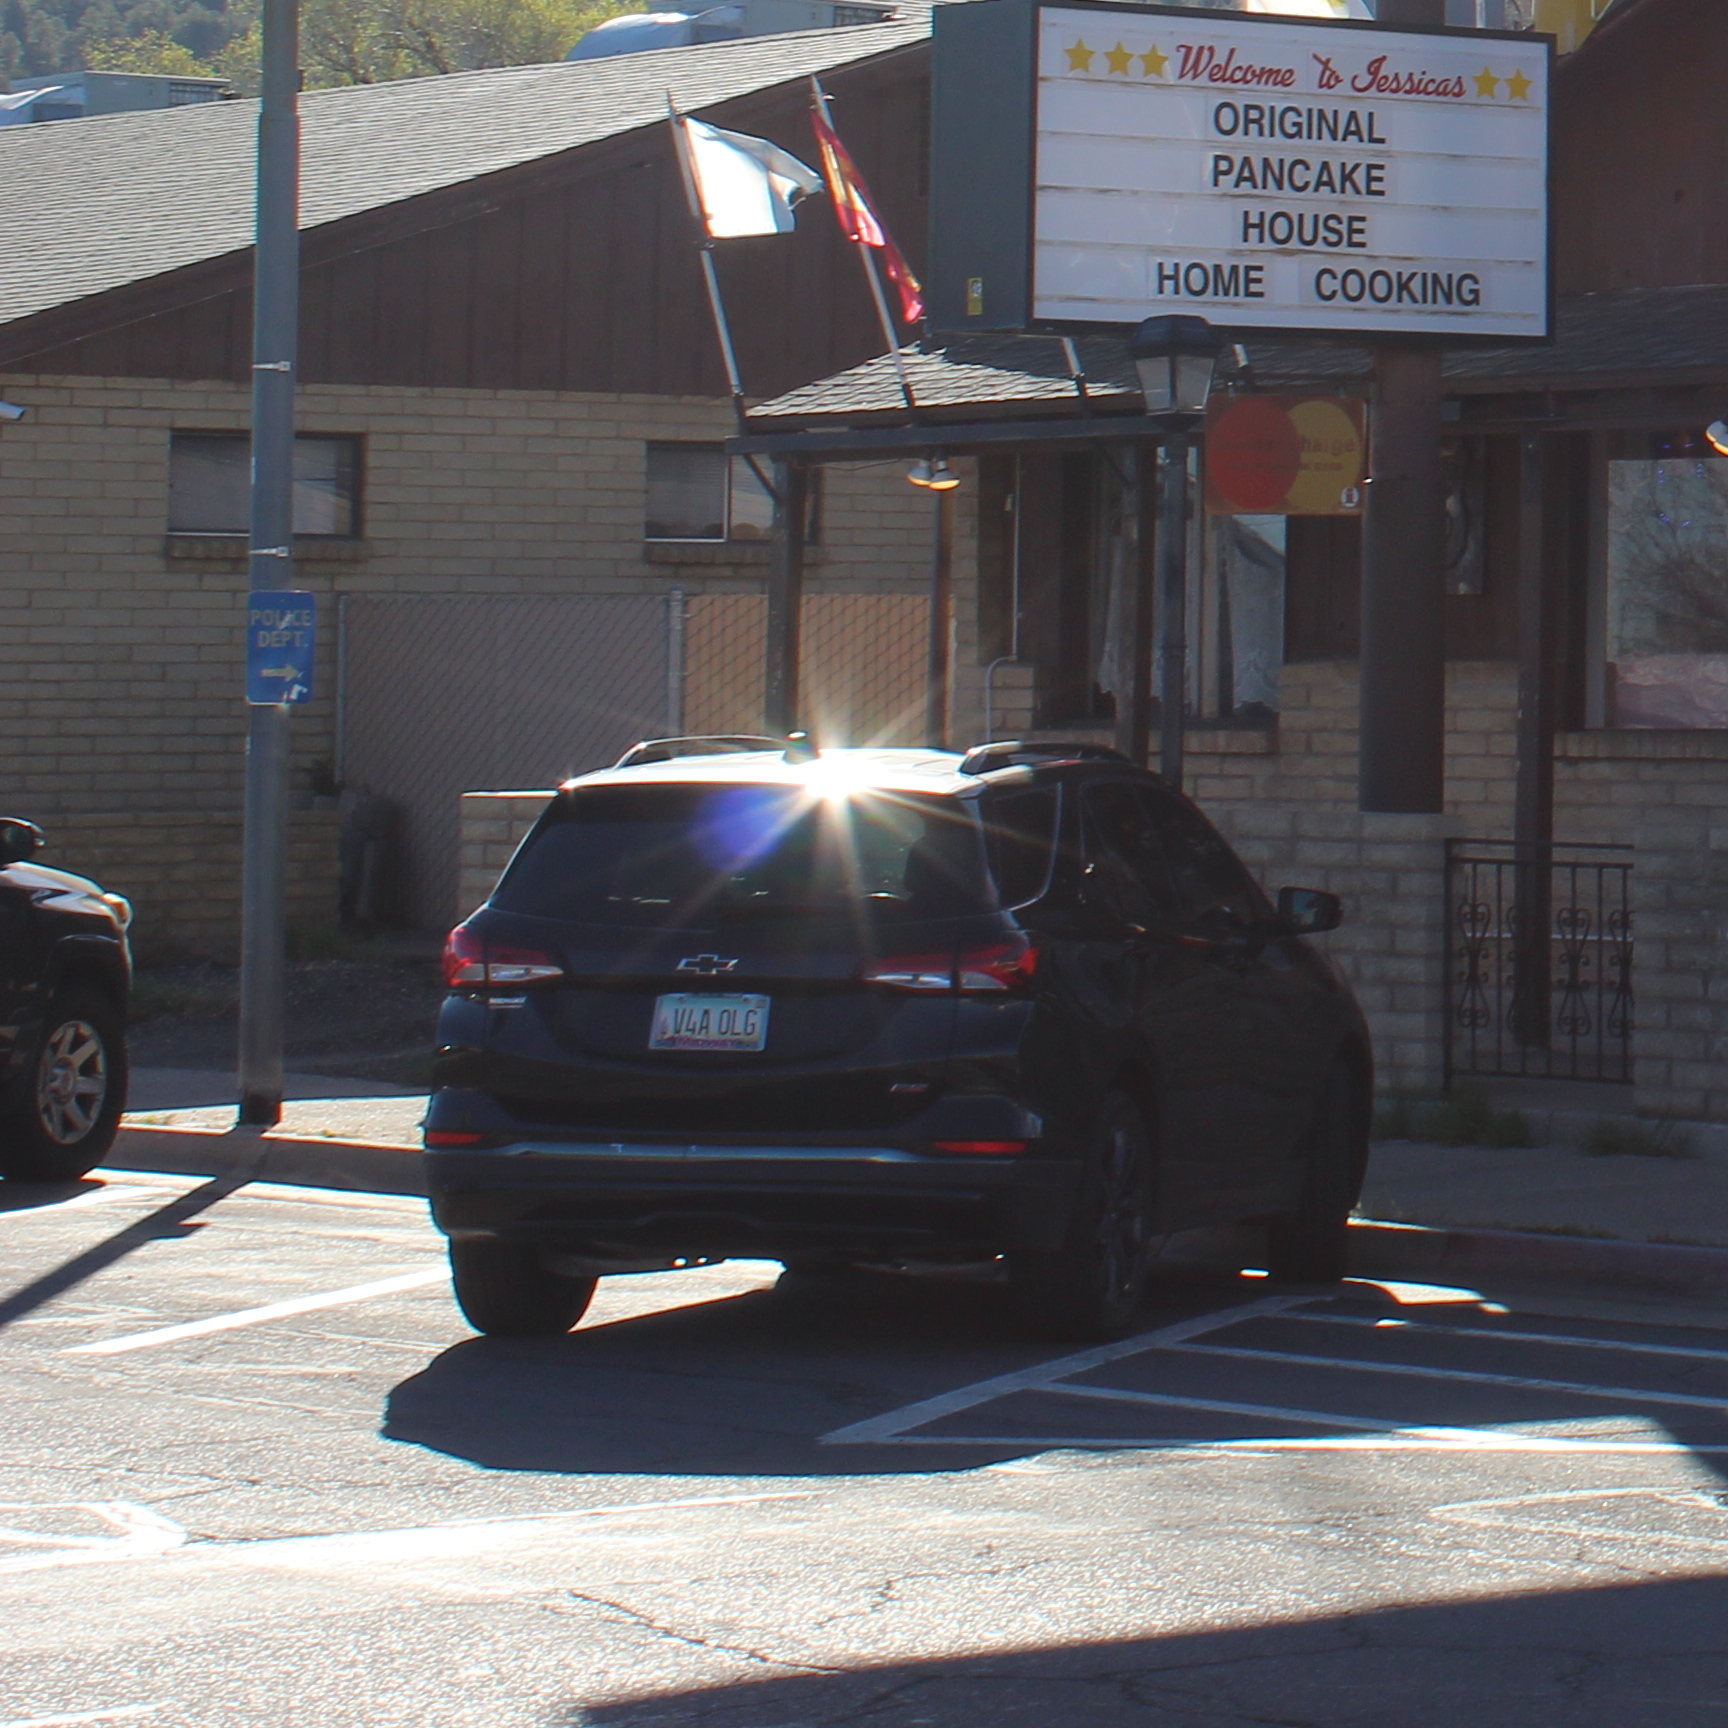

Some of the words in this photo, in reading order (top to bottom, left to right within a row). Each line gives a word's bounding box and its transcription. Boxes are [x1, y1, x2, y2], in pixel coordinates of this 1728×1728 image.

[1176, 44, 1297, 88] Welcome
[1312, 52, 1345, 90] to
[1351, 55, 1467, 99] Jessicas
[1213, 101, 1387, 145] ORIGINAL
[1212, 154, 1386, 197] PANCAKE
[1242, 210, 1367, 249] HOUSE
[1157, 261, 1265, 298] HOME
[1315, 267, 1481, 306] COOKING
